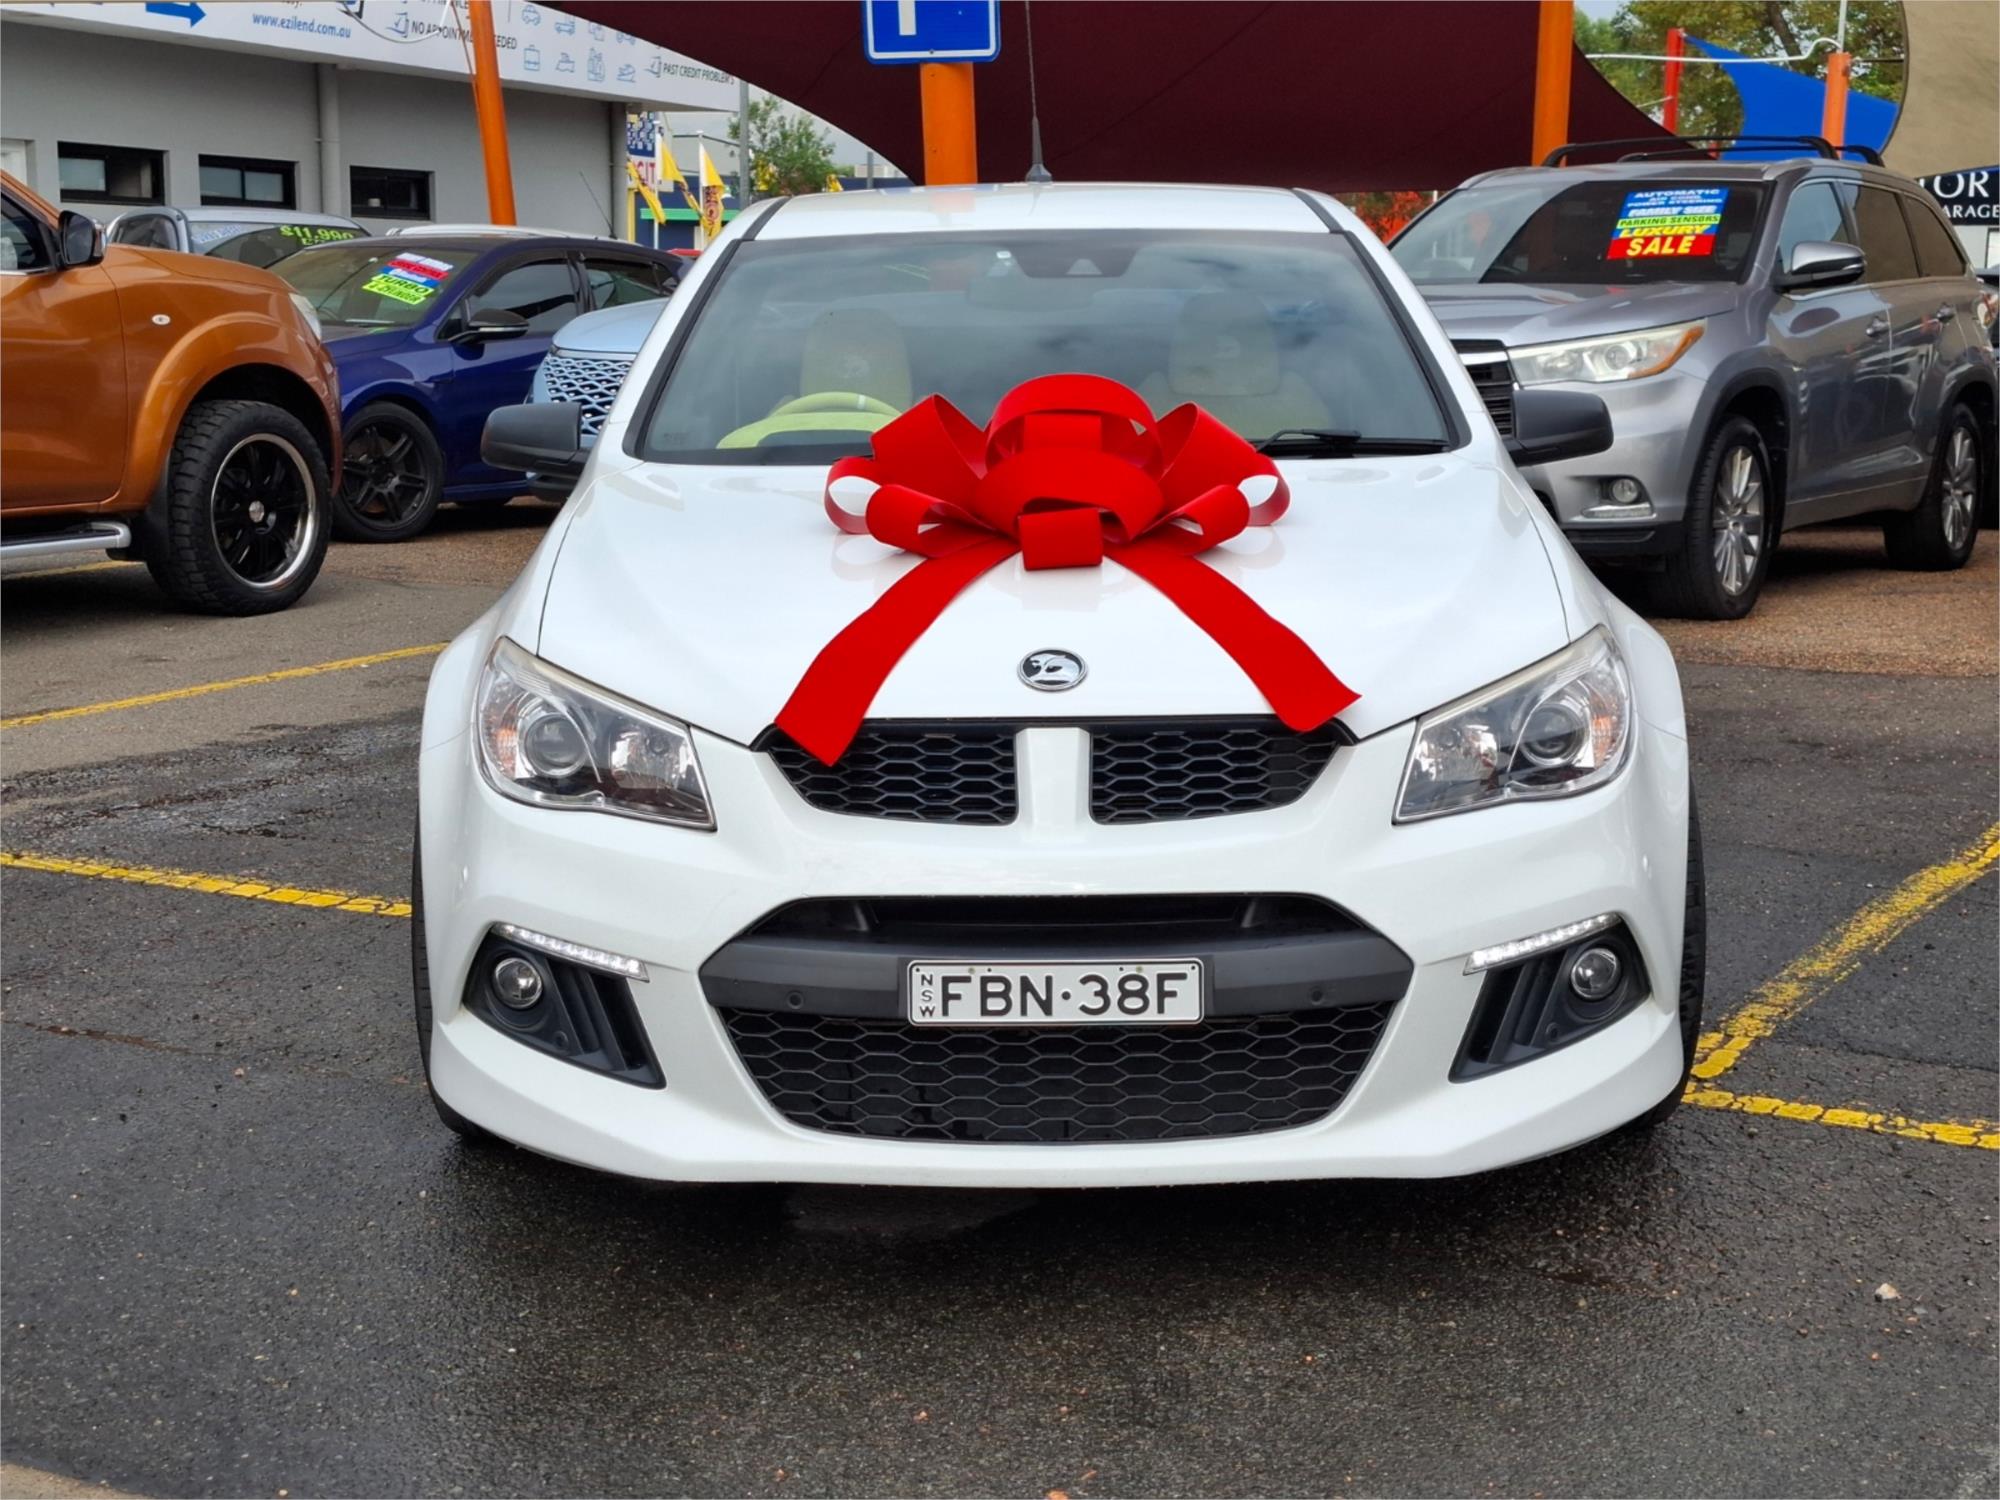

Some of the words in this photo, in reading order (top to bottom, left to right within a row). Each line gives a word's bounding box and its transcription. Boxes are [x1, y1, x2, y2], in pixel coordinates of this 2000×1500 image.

[252, 13, 351, 38] www.ezilend.com.au
[411, 20, 425, 35] NO
[494, 34, 517, 50] EDED
[663, 62, 679, 76] PAST
[680, 66, 701, 79] CREDIT
[1919, 170, 1989, 198] OR
[1634, 188, 1720, 199] AUTOMATIC
[1626, 200, 1666, 208] POWER
[1668, 198, 1723, 206] STEERING
[1942, 203, 2000, 218] ARAGE
[1620, 217, 1667, 227] PARKING
[1670, 214, 1719, 224] SENSORS
[1619, 224, 1711, 238] LUXURY
[1626, 236, 1697, 256] SALE
[381, 275, 430, 294] TURBO
[919, 974, 936, 1018] NSW
